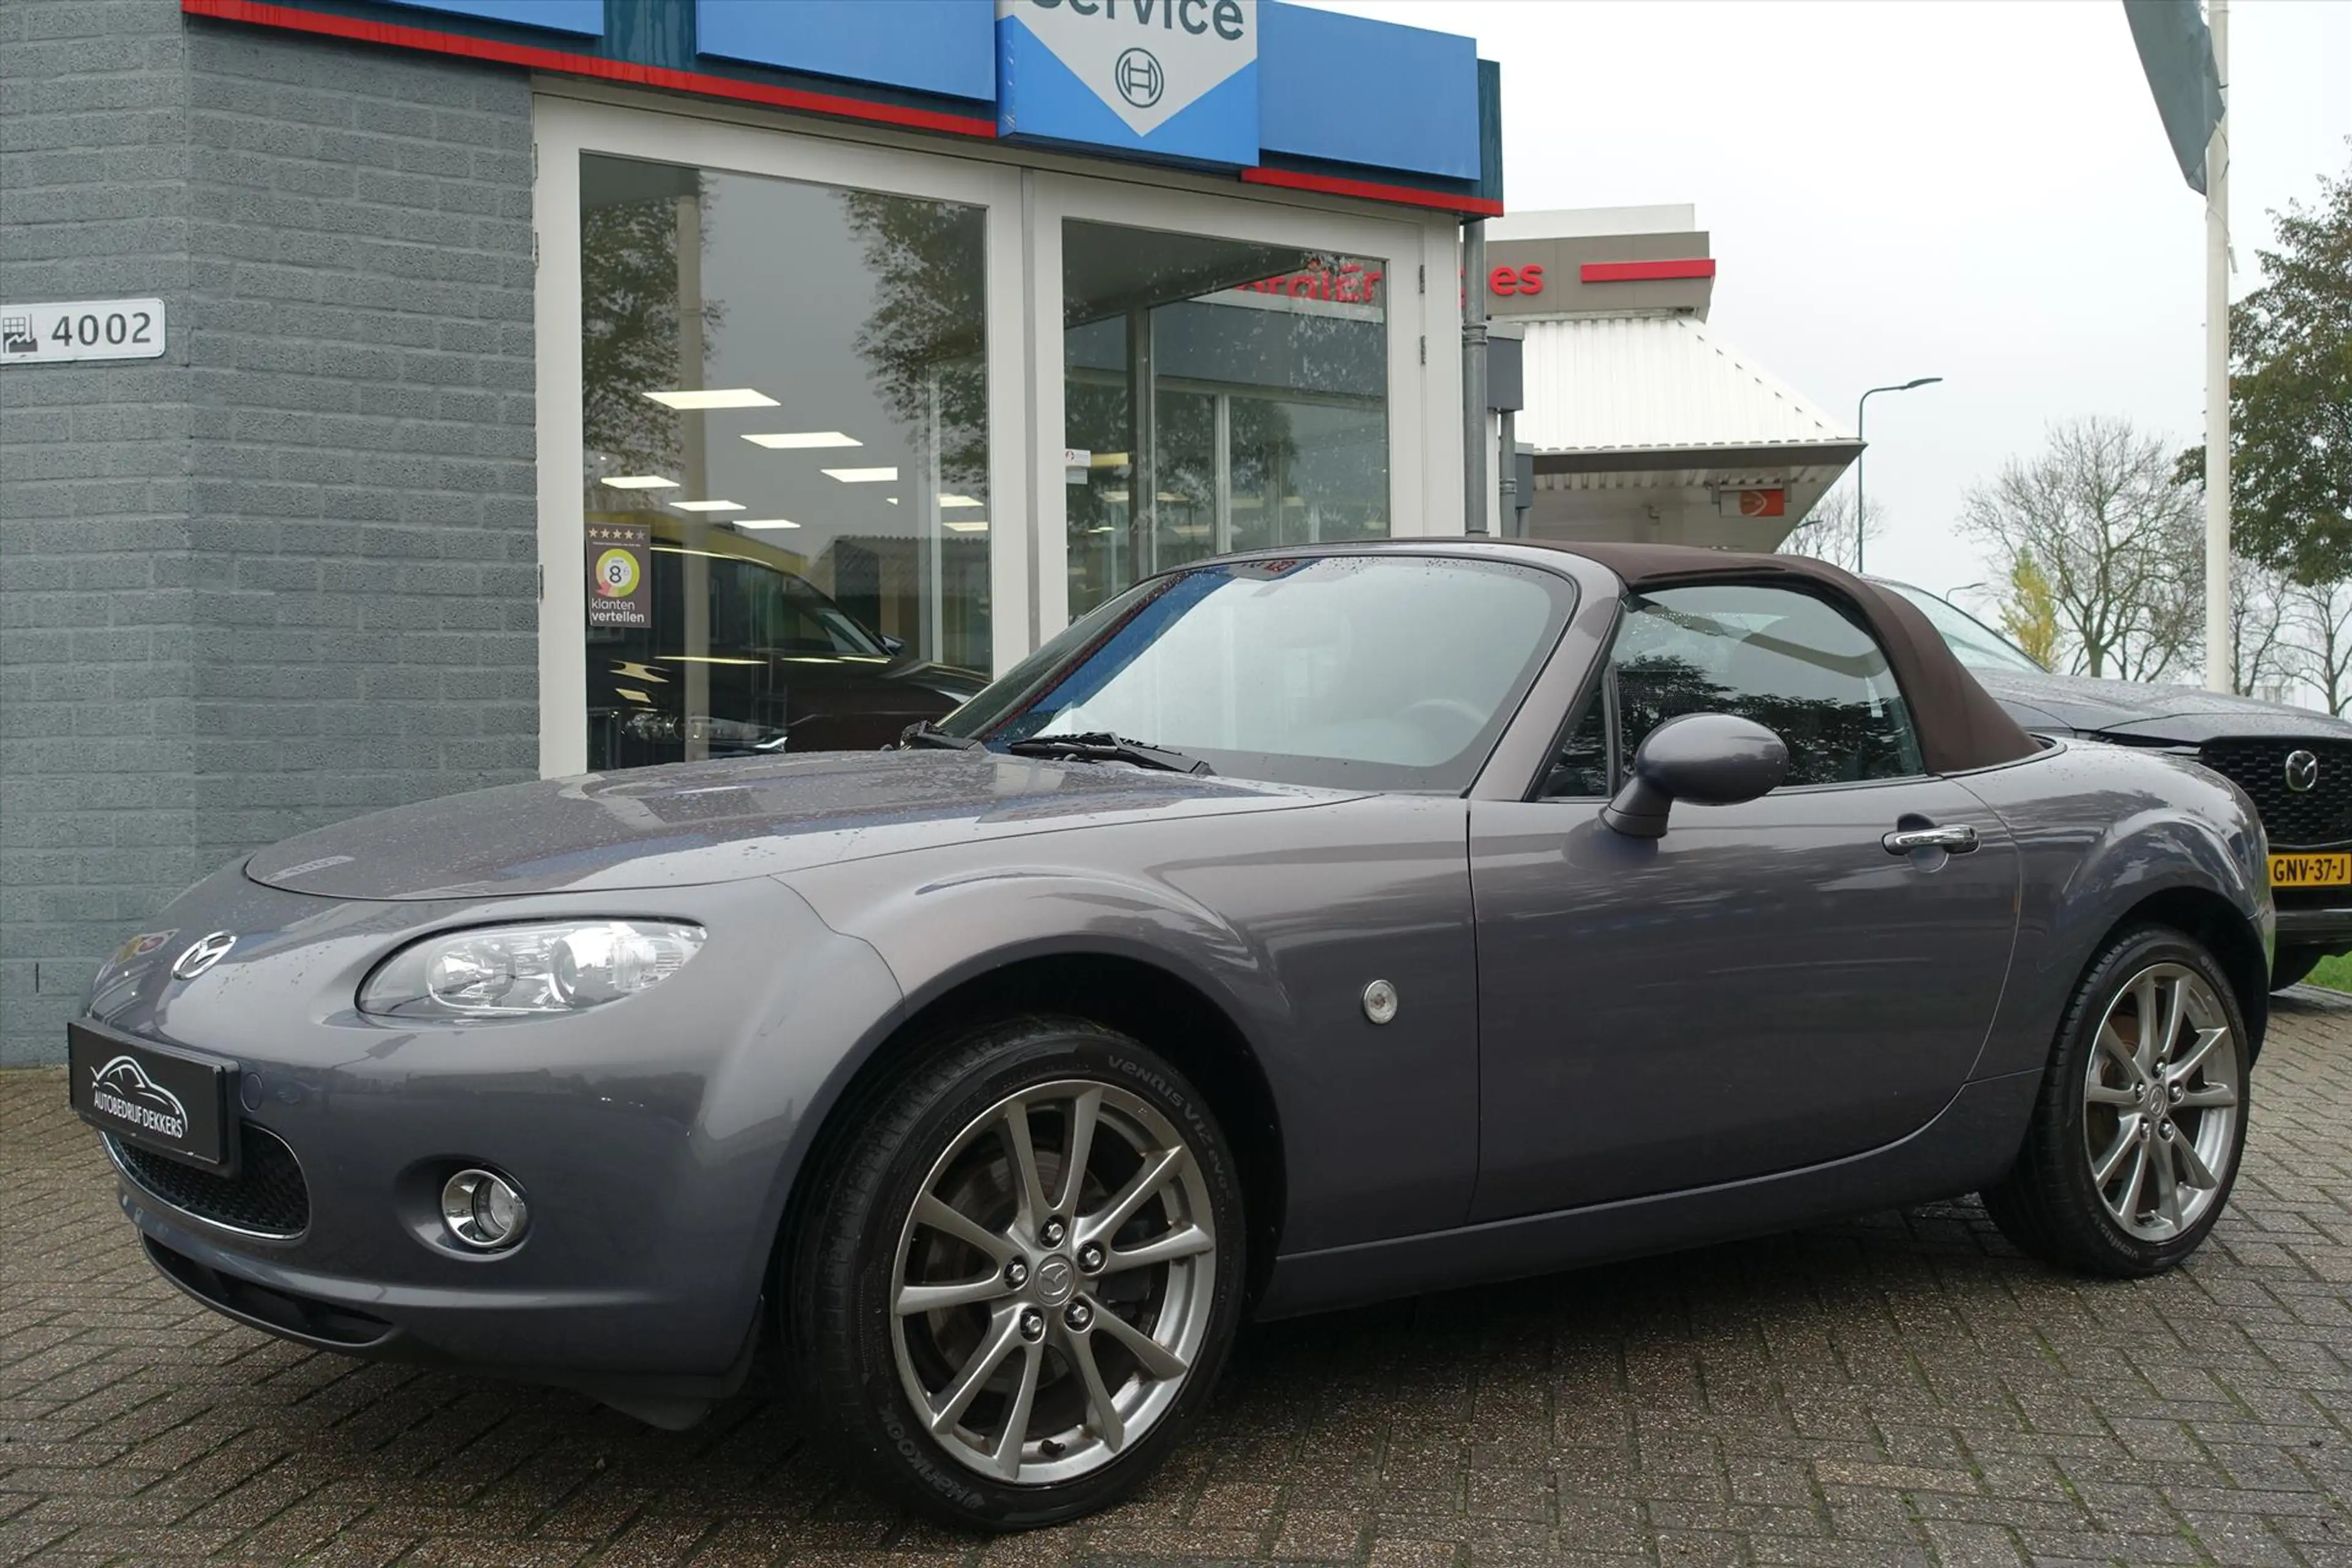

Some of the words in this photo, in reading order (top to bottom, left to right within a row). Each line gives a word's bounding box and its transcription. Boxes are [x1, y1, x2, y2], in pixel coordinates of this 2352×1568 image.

[51, 312, 151, 347] 4002
[591, 598, 635, 610] klanten
[591, 611, 645, 622] vertellen
[2274, 858, 2345, 882] GNV-37-J
[94, 1089, 142, 1125] AUTOBEDRIJF
[142, 1107, 183, 1139] DEKKERS
